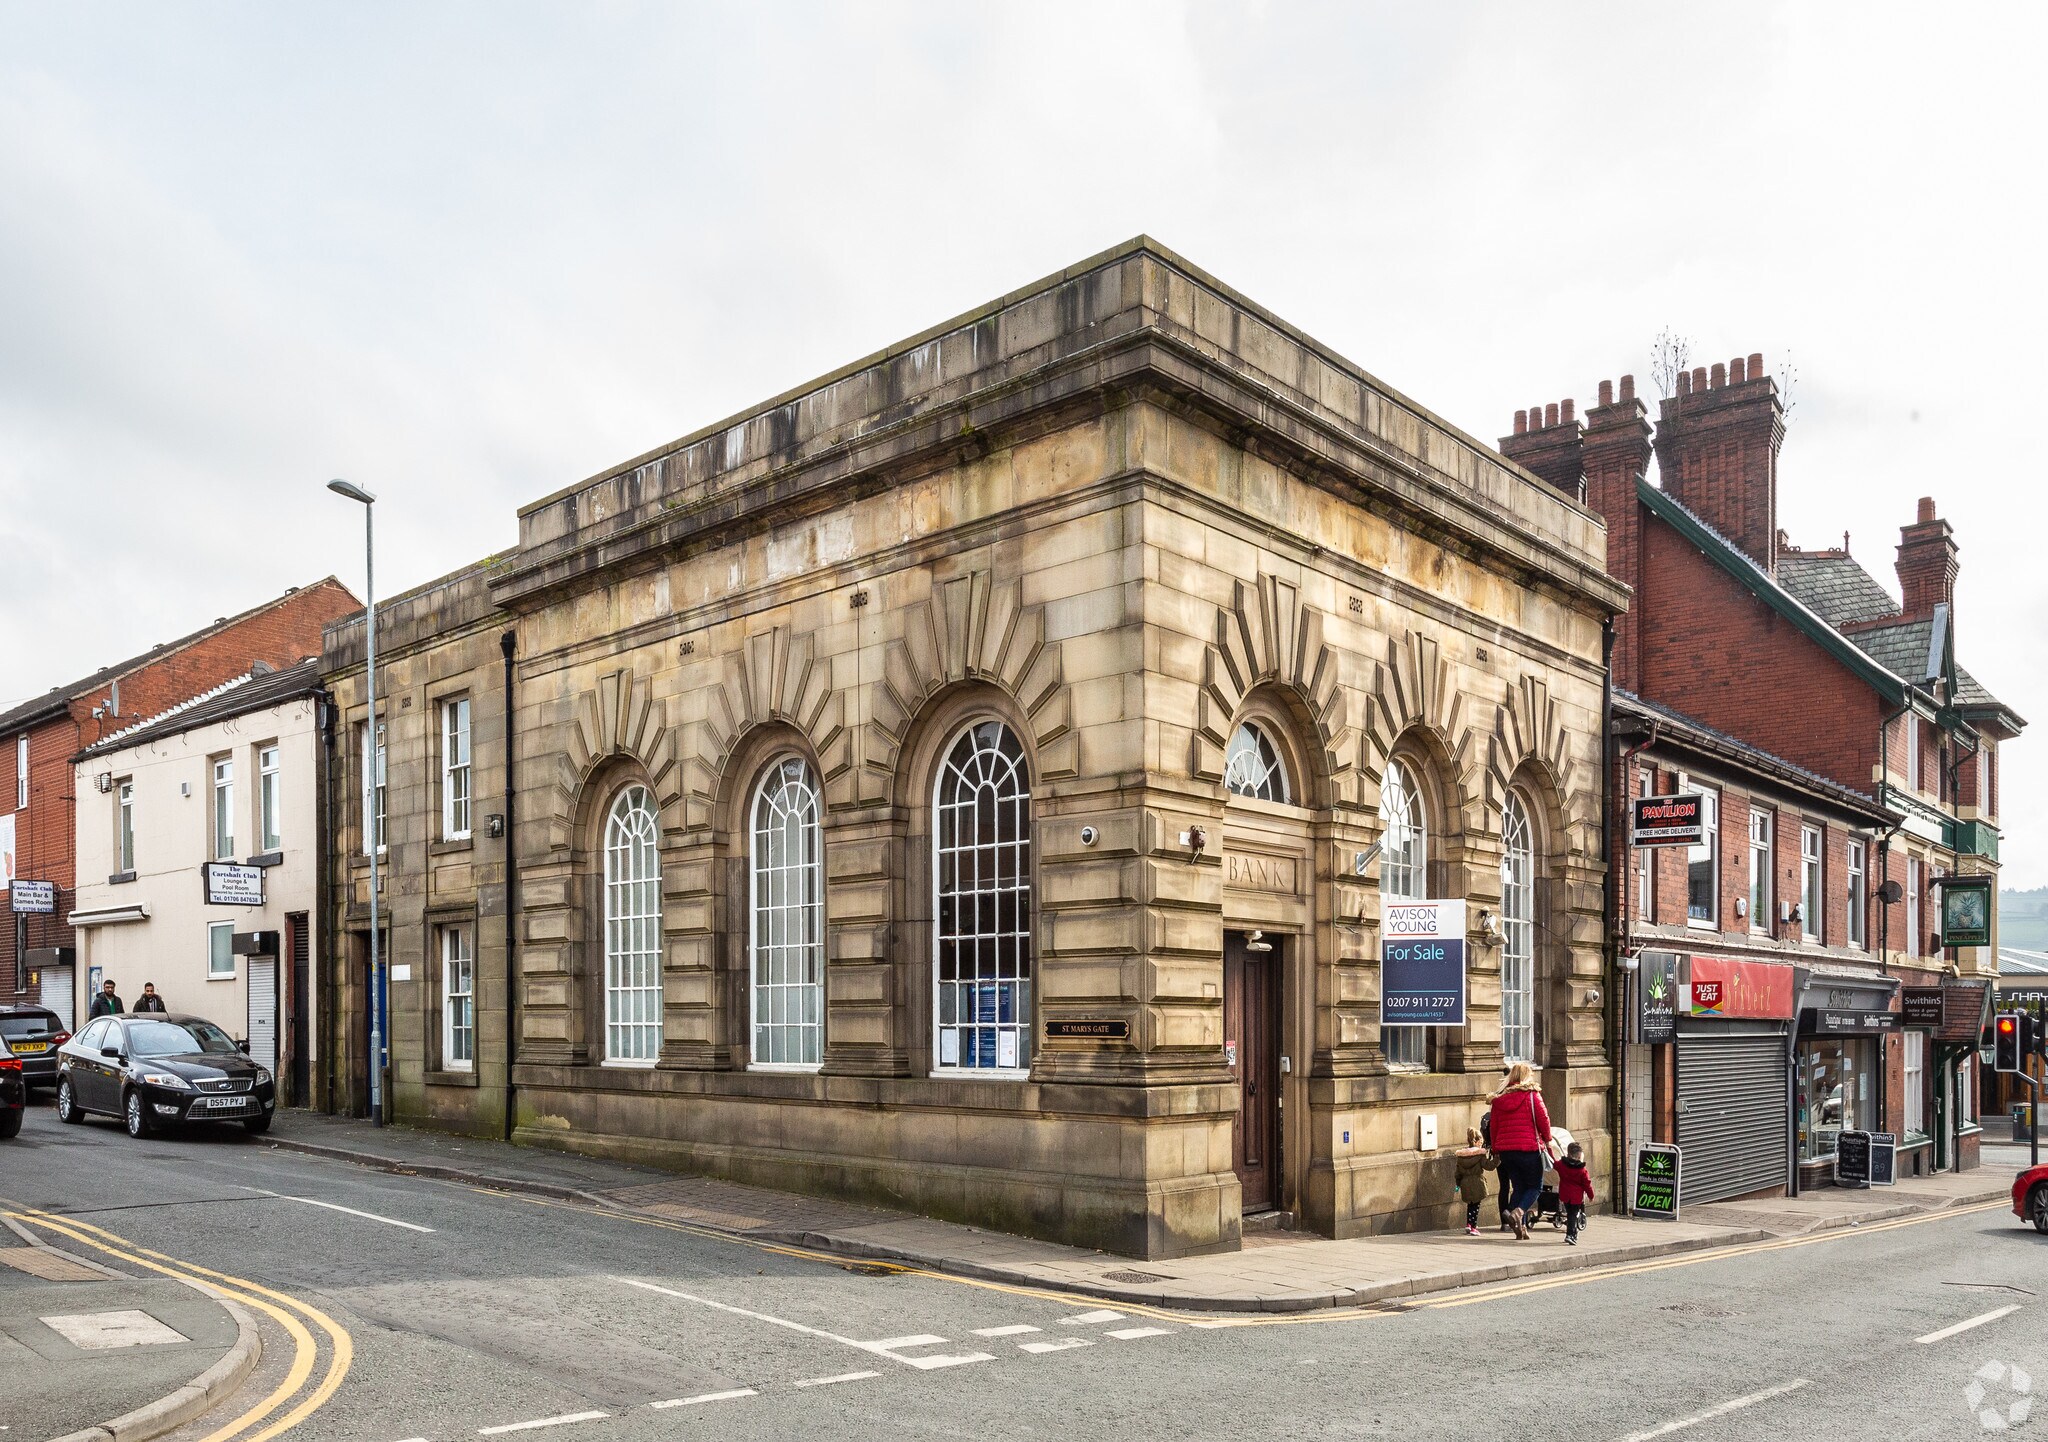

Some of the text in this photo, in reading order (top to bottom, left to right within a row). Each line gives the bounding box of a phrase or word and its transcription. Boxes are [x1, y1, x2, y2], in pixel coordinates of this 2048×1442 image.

[1642, 803, 1695, 819] PAVILION
[1229, 856, 1285, 887] BANK
[1389, 908, 1437, 920] AVISON
[1389, 921, 1437, 932] YOUNG
[1386, 943, 1444, 960] For Sale
[1696, 984, 1718, 994] JUST
[1387, 997, 1455, 1007] 0207 911 2727
[1701, 993, 1718, 1001] EAT
[1904, 997, 1941, 1005] SwithinS
[1644, 1002, 1672, 1015] Sunshine
[1639, 1167, 1674, 1177] Sunshine
[1640, 1184, 1672, 1193] Showroom
[1638, 1193, 1672, 1209] OPEN
